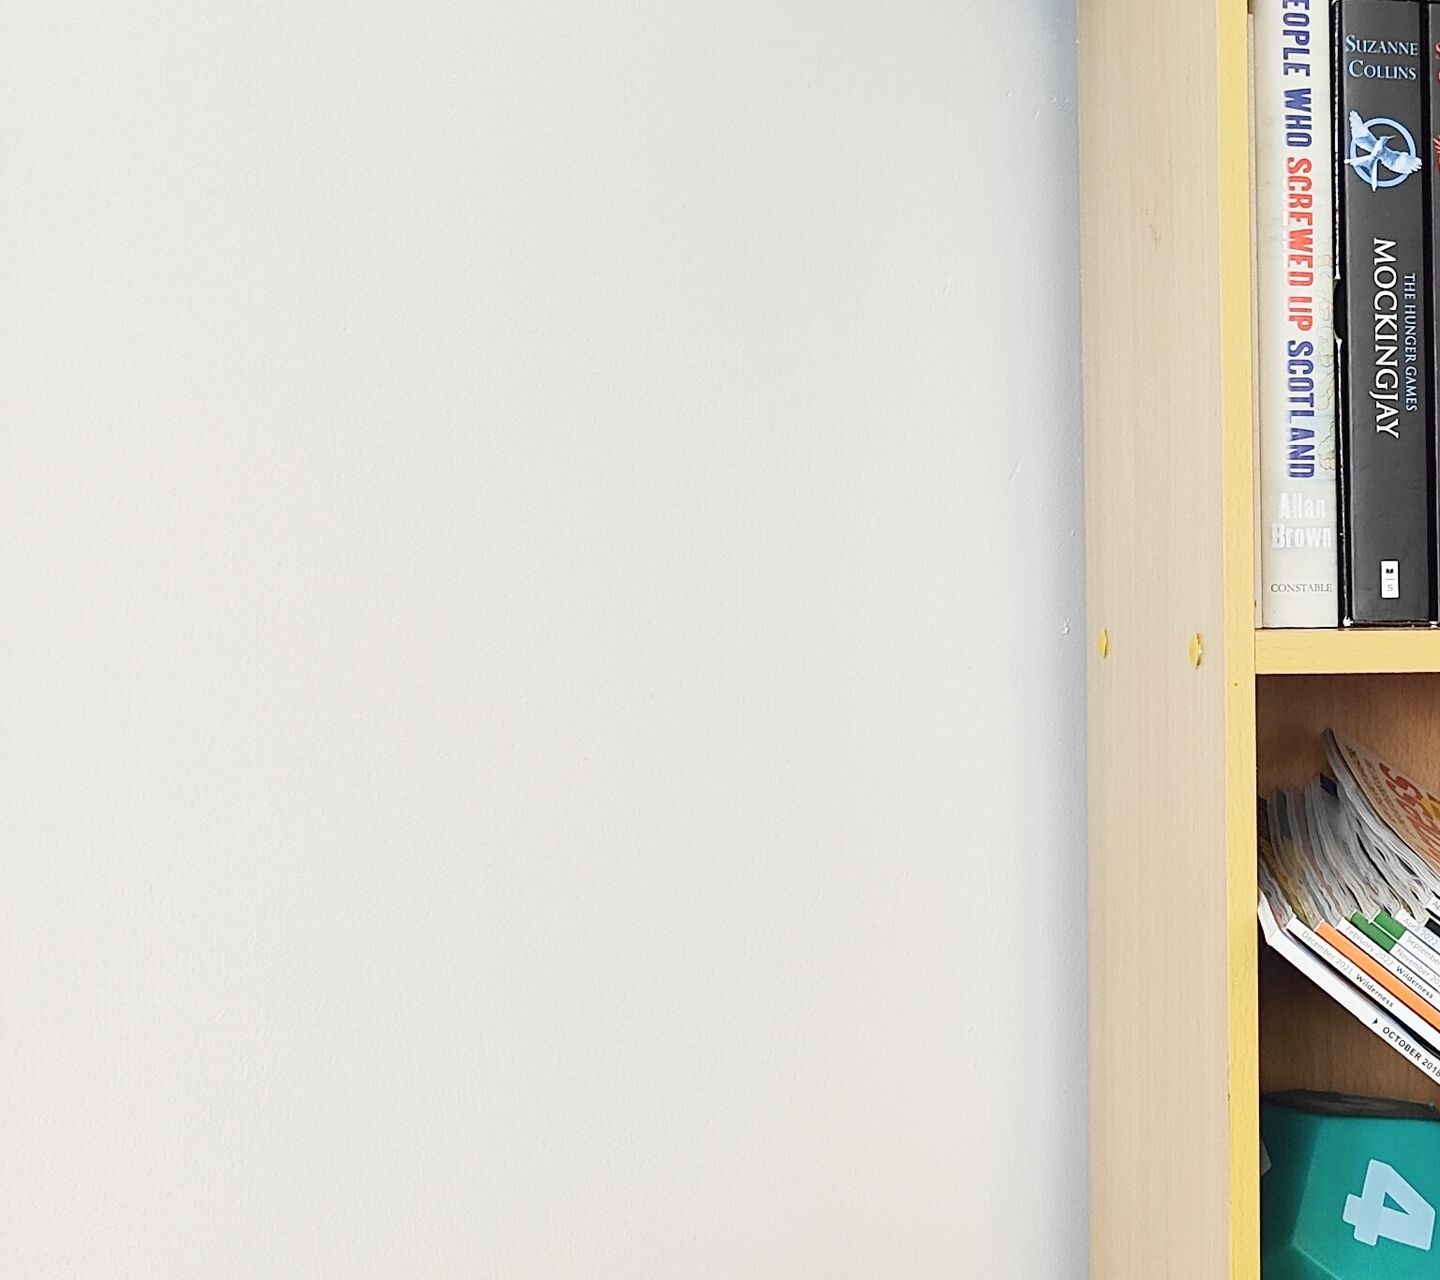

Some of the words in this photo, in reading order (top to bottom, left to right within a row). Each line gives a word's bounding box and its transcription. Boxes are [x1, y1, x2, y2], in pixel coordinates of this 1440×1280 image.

[1284, 88, 1313, 148] WHO
[1283, 157, 1314, 287] SCREWED
[1404, 273, 1417, 300] THE
[1287, 296, 1314, 331] UP
[1404, 303, 1418, 363] HUNGER
[1369, 238, 1399, 439] MOCKINGJAY
[1287, 339, 1315, 479] SCOTLAND
[1405, 366, 1418, 412] GAMES
[1279, 491, 1326, 520] Allan
[1271, 522, 1332, 549] Brown
[1270, 583, 1333, 593] CONSTABLE
[1401, 916, 1421, 934] April
[1300, 930, 1337, 961] December
[1353, 972, 1396, 1008] Wilderness
[1342, 925, 1377, 954] February
[1394, 964, 1436, 999] Wilderness
[1394, 947, 1431, 978] November
[1380, 1025, 1424, 1062] OCTOBER
[1343, 1159, 1436, 1251] 4
